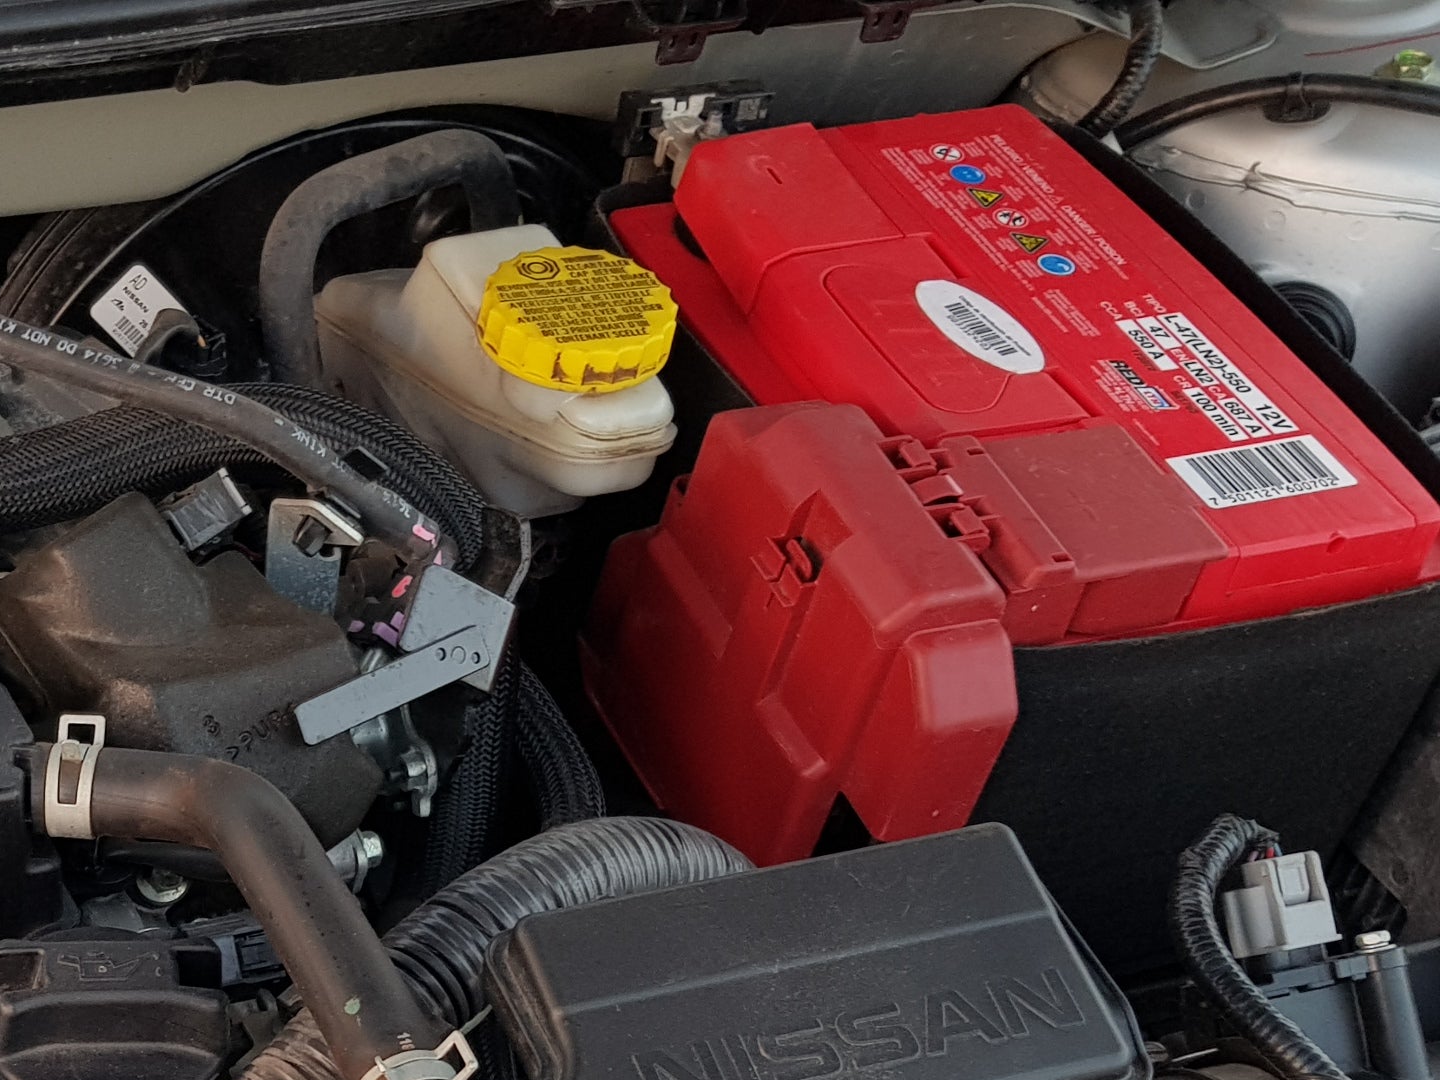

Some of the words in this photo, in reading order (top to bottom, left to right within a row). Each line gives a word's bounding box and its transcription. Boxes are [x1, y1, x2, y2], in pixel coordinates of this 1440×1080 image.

[122, 286, 149, 314] NISSAN
[1099, 300, 1123, 322] CCA
[1127, 329, 1157, 350] 550
[1148, 349, 1166, 361] A
[1173, 374, 1191, 390] CR
[1188, 390, 1218, 415] 100
[1123, 300, 1145, 318] BCI
[1147, 324, 1171, 340] 47
[1183, 360, 1214, 385] LN2
[1208, 385, 1227, 402] CA
[1223, 400, 1252, 423] 687
[1246, 423, 1263, 435] A
[1141, 293, 1167, 315] TIPO
[1163, 313, 1253, 395] L-47(LN2)-550
[1254, 402, 1294, 431] 12V
[1208, 496, 1220, 507] 7
[1226, 486, 1282, 505] 501121
[1286, 477, 1338, 494] 600702
